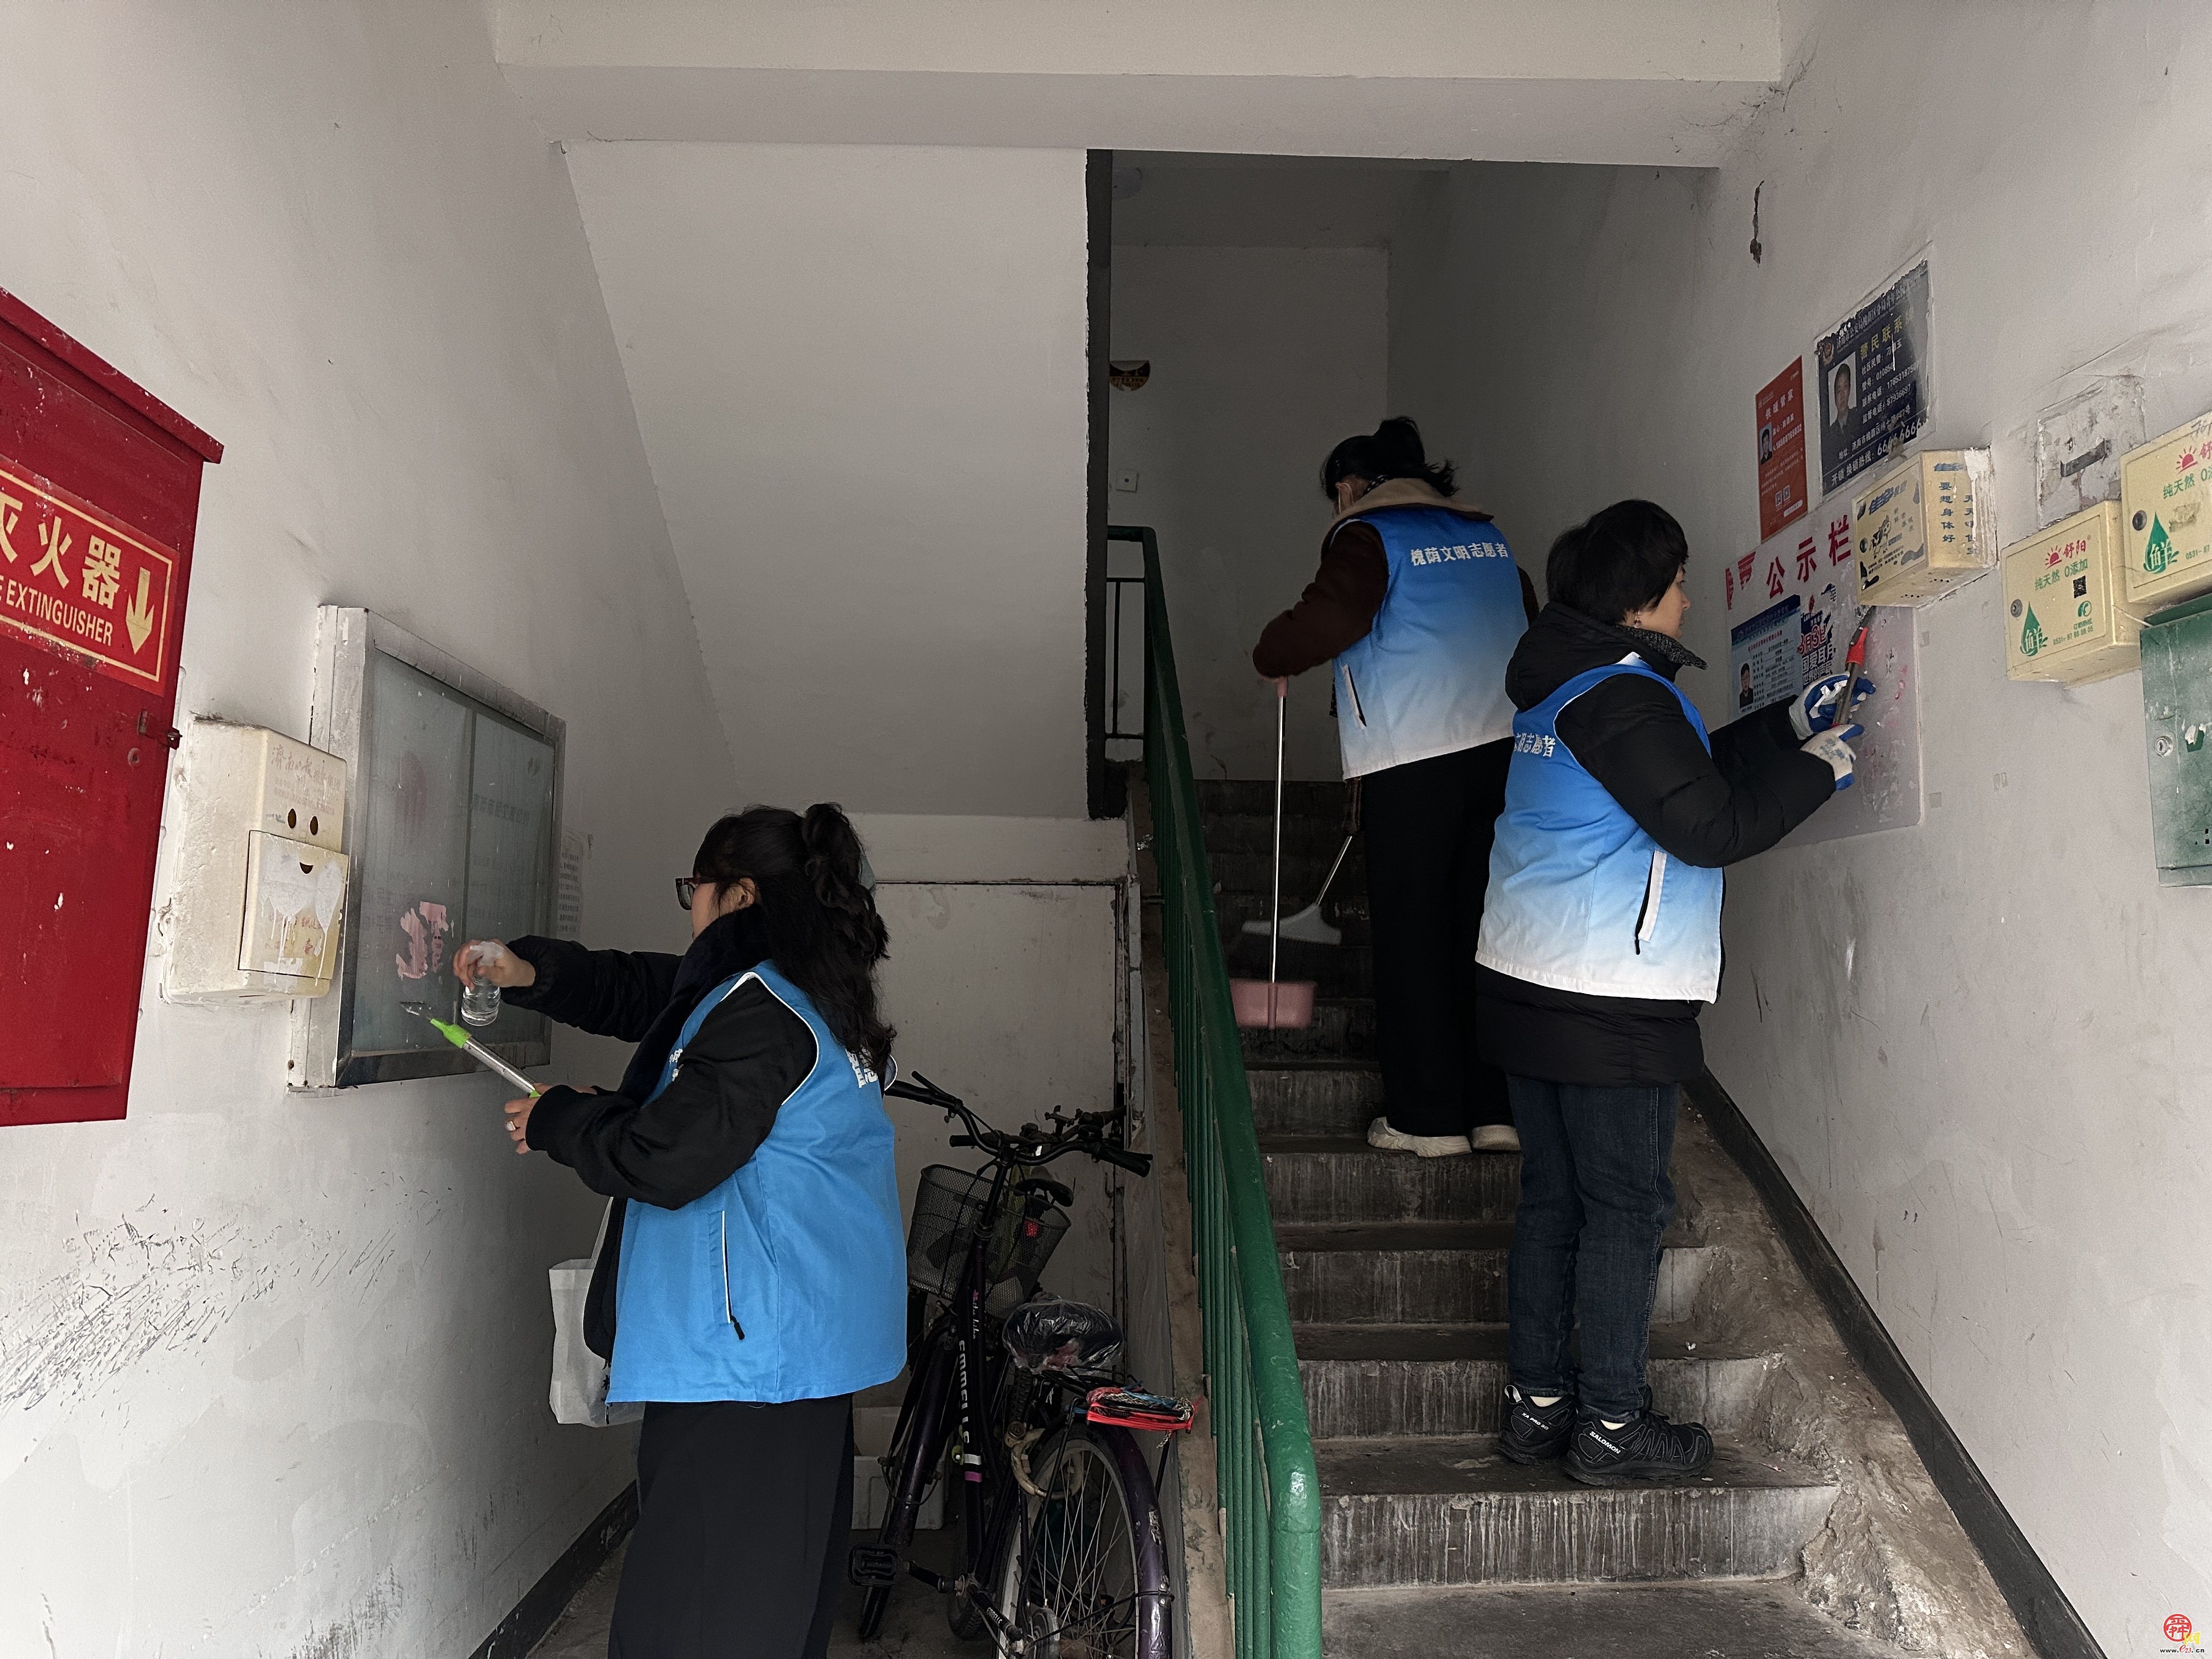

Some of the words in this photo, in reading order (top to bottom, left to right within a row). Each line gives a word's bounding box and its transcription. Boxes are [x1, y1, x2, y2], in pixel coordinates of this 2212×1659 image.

[2163, 473, 2195, 499] 纯天然
[1938, 482, 1956, 543] 要想身体好
[1410, 542, 1508, 566] 槐荫文明志愿者
[2063, 539, 2086, 558] 舒阳
[2034, 569, 2060, 590] 纯天然
[2064, 558, 2089, 578] 0添加
[7, 578, 114, 646] EXTINGUISHER
[1589, 1431, 1621, 1454] SALOMON
